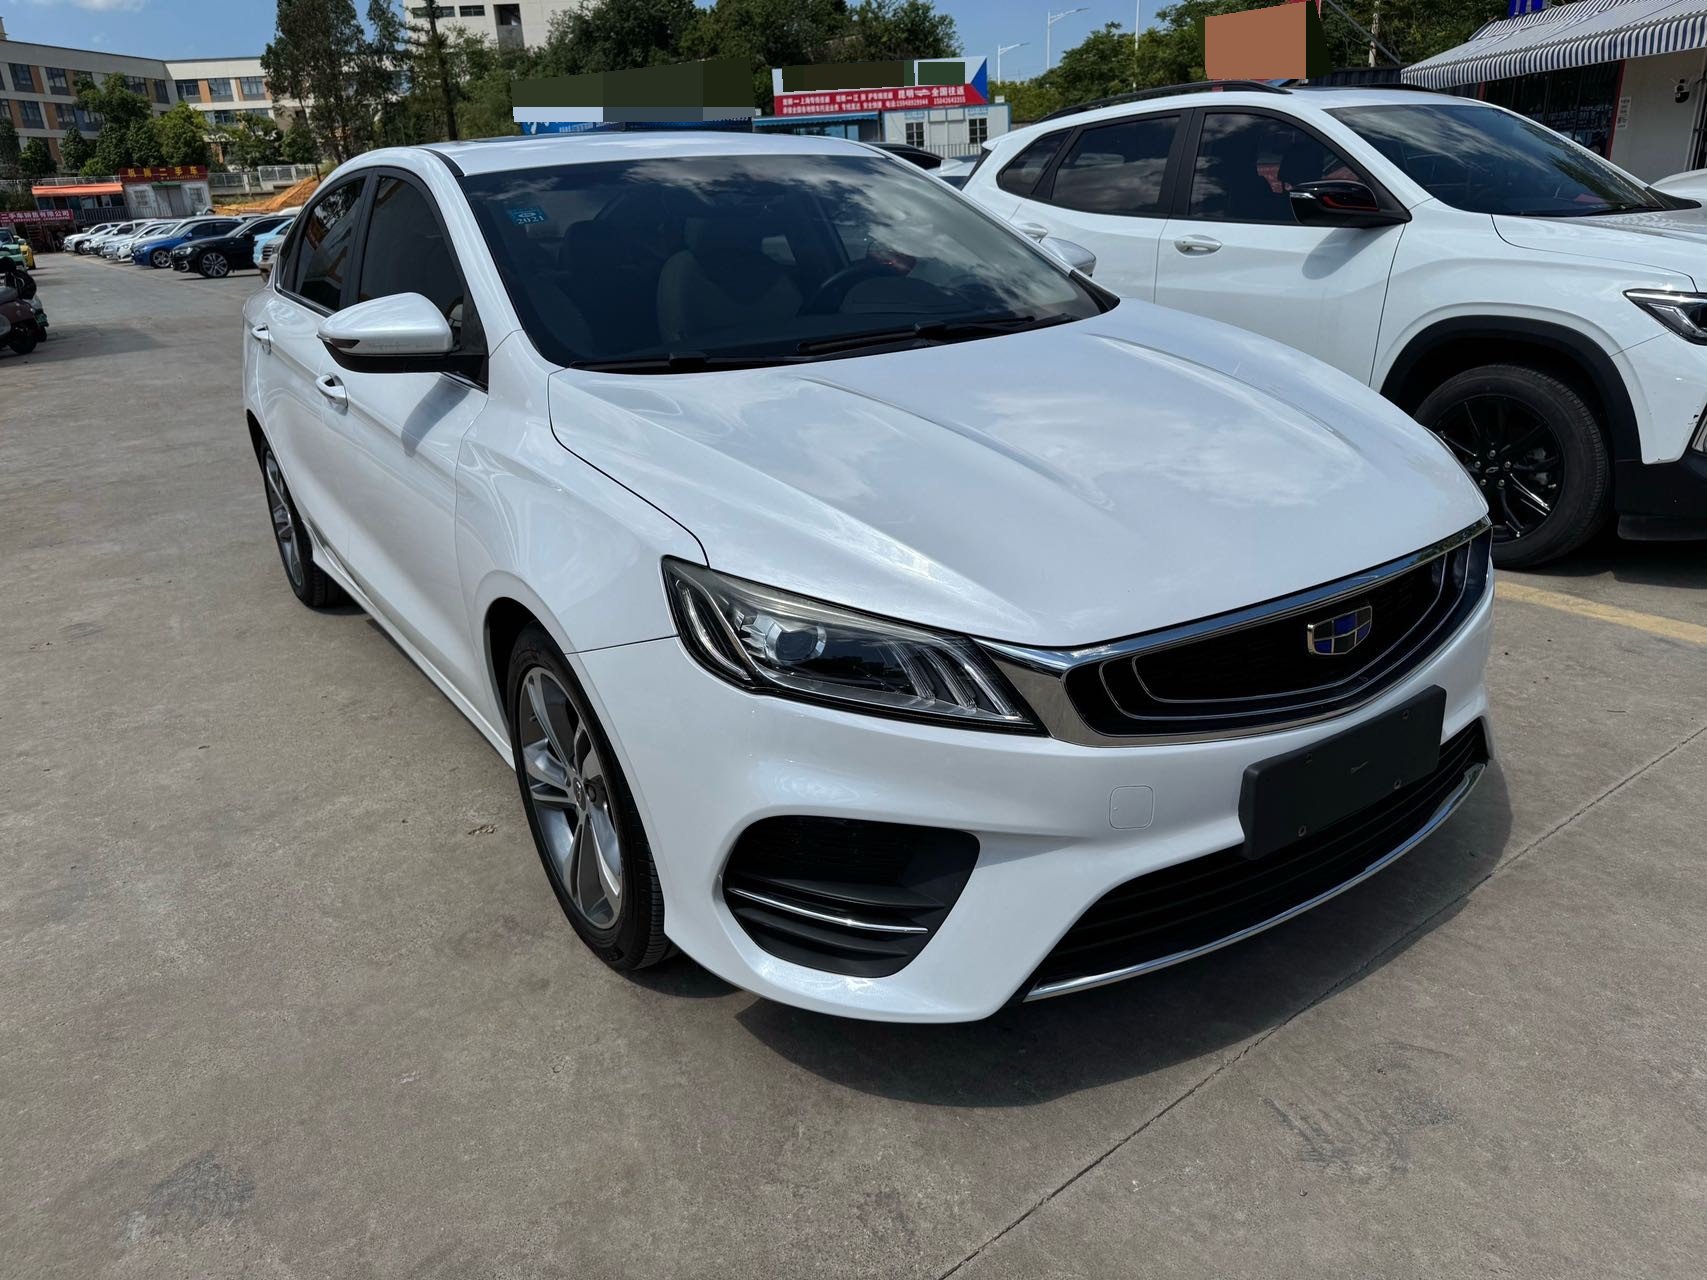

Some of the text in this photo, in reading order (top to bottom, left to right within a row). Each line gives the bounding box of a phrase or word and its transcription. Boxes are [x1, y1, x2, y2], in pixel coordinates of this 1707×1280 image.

[931, 86, 965, 97] 全国往返
[516, 215, 544, 225] 2021
